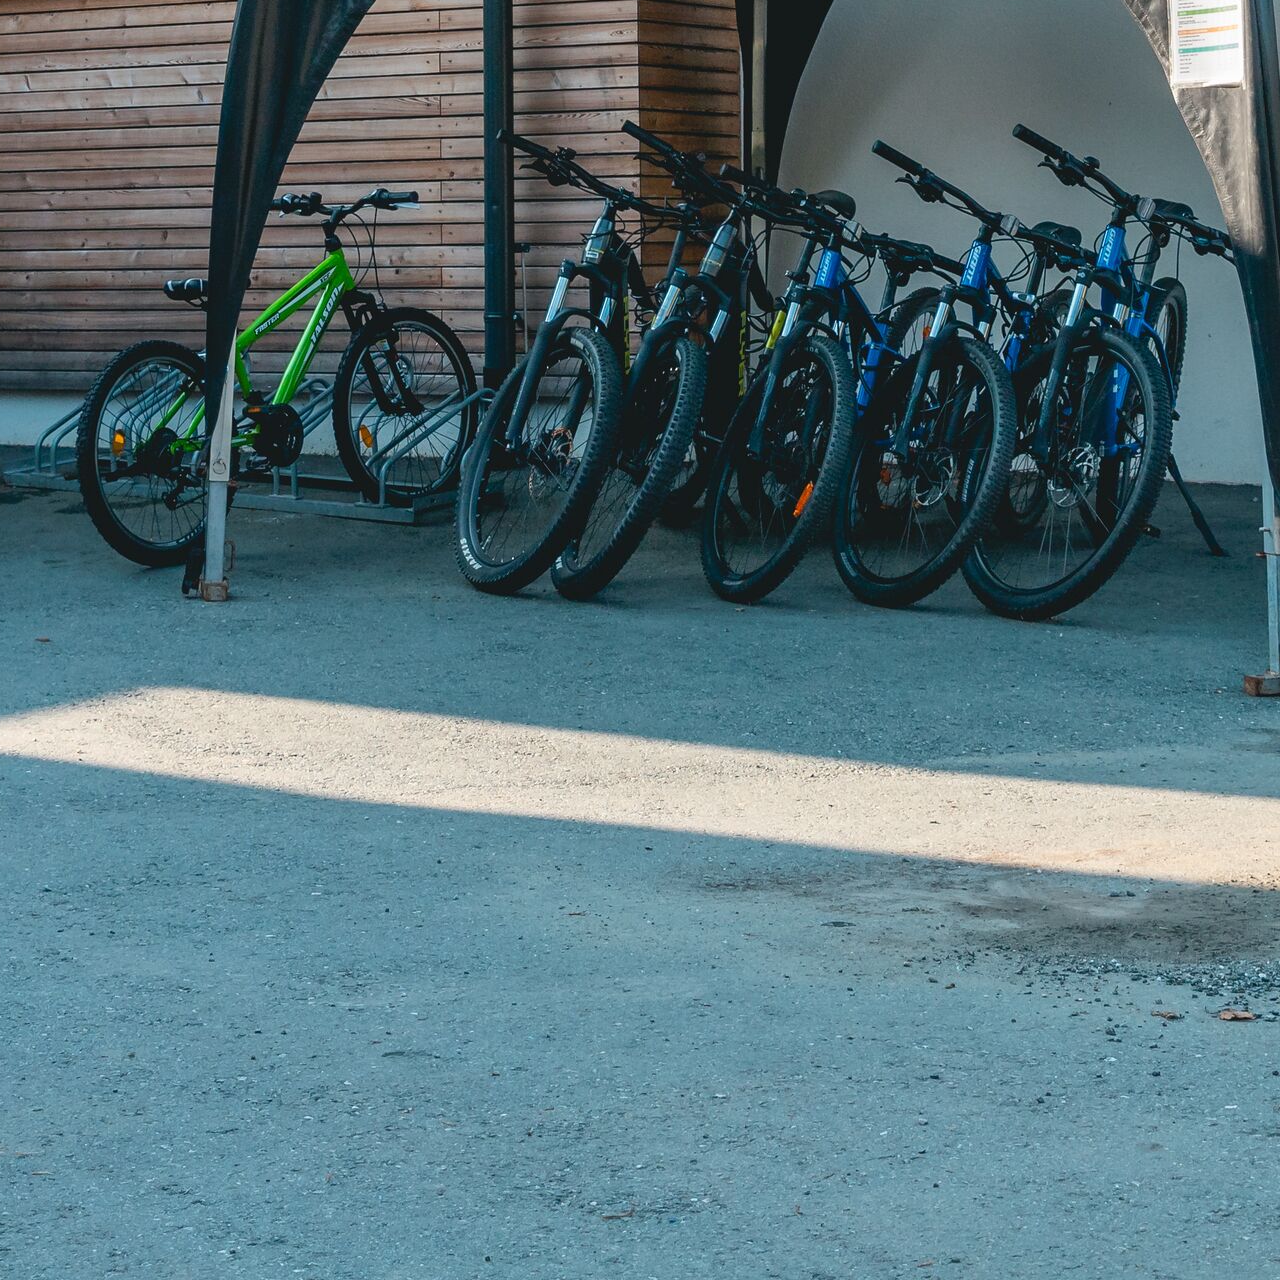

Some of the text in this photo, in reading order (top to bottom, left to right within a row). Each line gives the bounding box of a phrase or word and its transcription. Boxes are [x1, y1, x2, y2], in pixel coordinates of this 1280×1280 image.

[254, 312, 281, 336] FASTER
[310, 287, 340, 344] TALSON
[459, 537, 482, 570] MAXXIS
